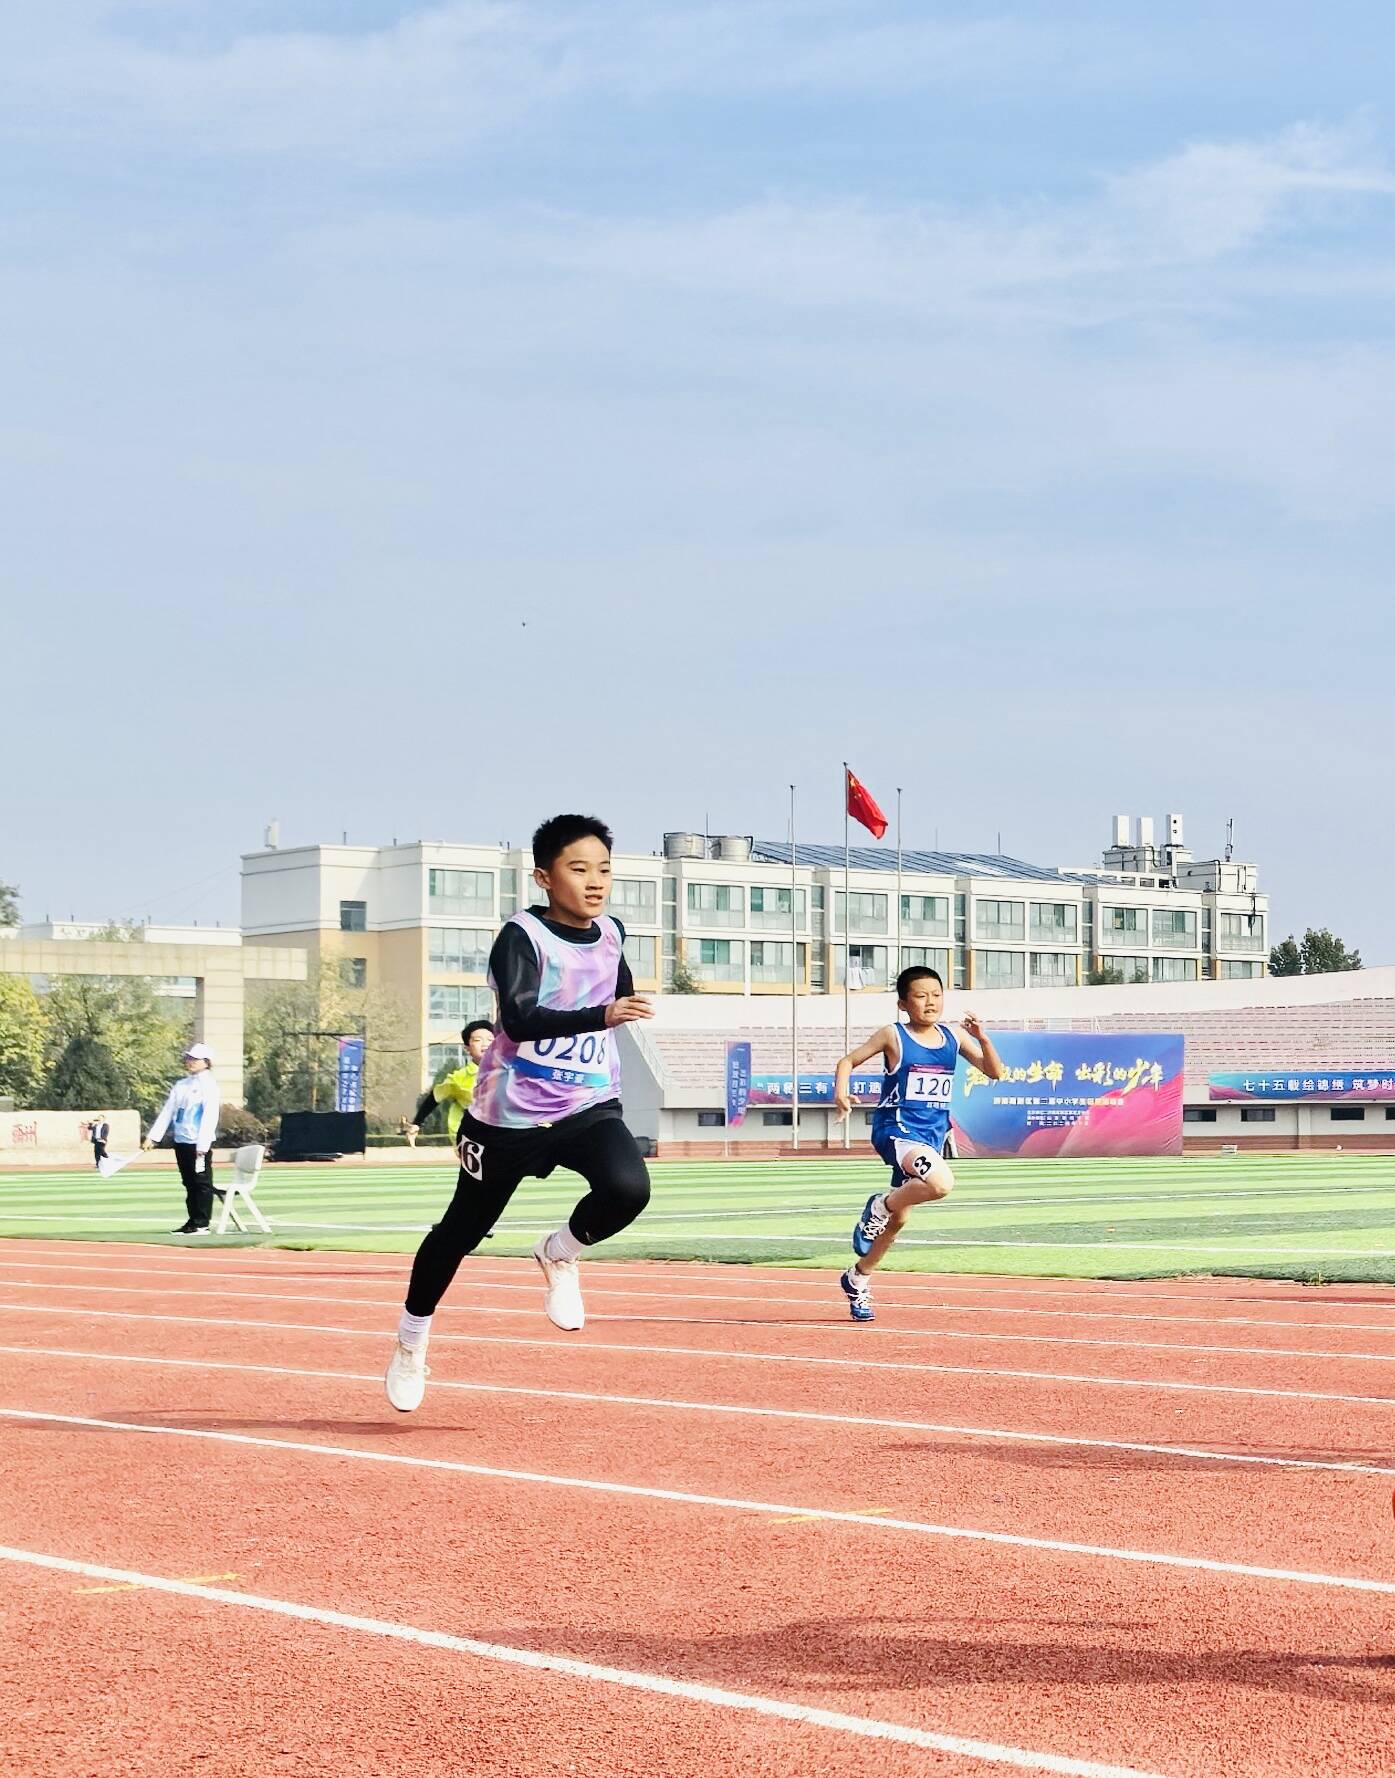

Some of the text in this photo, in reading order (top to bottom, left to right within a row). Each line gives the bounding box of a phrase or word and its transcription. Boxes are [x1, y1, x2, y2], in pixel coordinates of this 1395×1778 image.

[914, 1077, 951, 1097] 120
[461, 1140, 480, 1174] 6
[914, 1155, 932, 1176] 3
